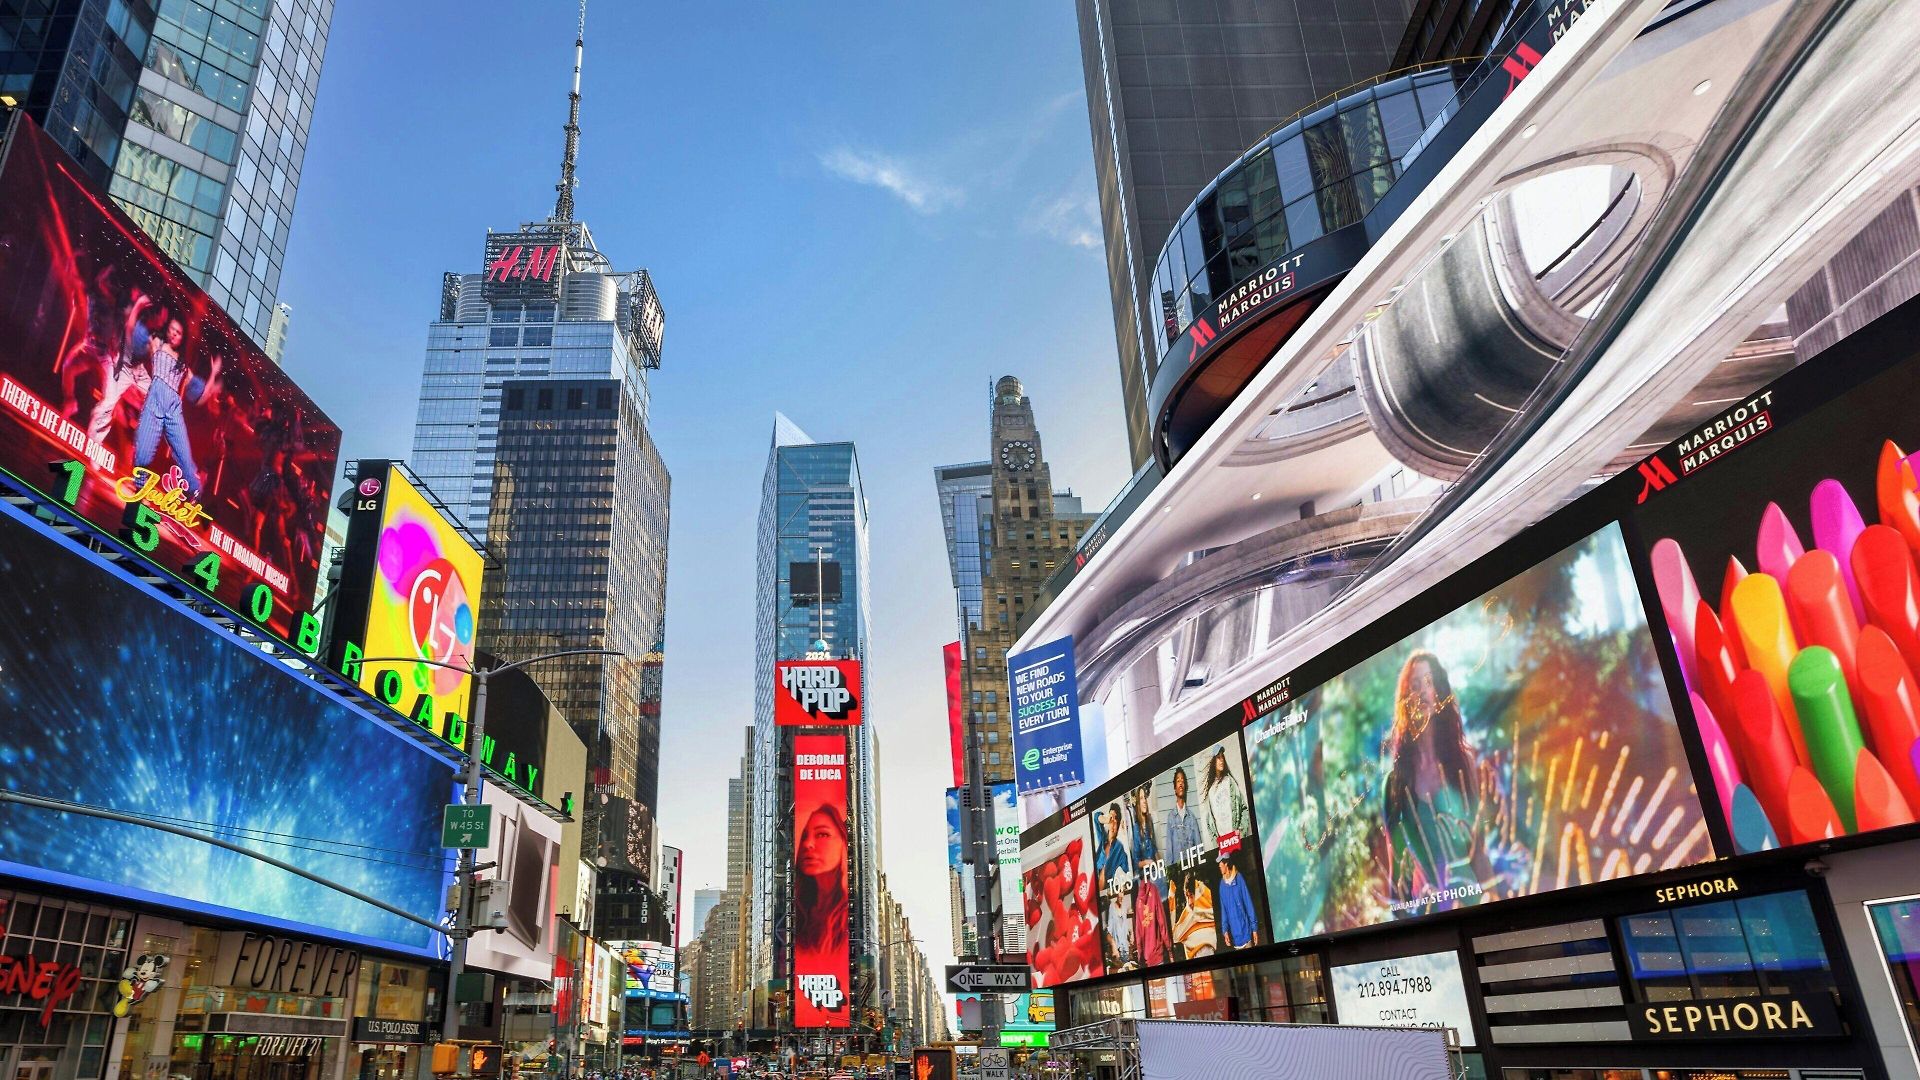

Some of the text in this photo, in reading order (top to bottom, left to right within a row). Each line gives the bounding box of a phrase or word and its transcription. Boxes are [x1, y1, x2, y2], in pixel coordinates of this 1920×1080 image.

[488, 246, 560, 283] H&M
[1218, 253, 1305, 315] MARRIOTT
[1220, 276, 1293, 329] MARQUIS
[0, 378, 116, 474] THERE'S LIFE AFTER ROMEO.
[1678, 390, 1773, 456] MARRIOTT
[1683, 415, 1768, 472] MARQUIS
[115, 466, 213, 528] Juliet
[357, 500, 377, 511] LG
[210, 525, 224, 548] THE
[221, 534, 235, 555] HIT
[805, 651, 831, 660] 2024
[779, 666, 841, 700] HARD
[1015, 665, 1050, 684] WE FIND
[1016, 671, 1066, 696] NEW ROADS
[297, 611, 538, 791] BROADWAY
[799, 687, 850, 713] POP
[1017, 687, 1053, 706] TO YOUR
[1256, 676, 1291, 703] MARRIOTT
[1258, 690, 1289, 713] MARQUIS
[1018, 694, 1069, 718] SUCCESS AT
[1019, 705, 1070, 729] EVERY TURN
[796, 754, 845, 766] DEBORAH
[1042, 742, 1073, 756] Enterprise
[800, 769, 841, 780] DE LUCA
[450, 821, 484, 830] W 45 St
[462, 809, 474, 818] TO
[1005, 837, 1019, 845] One
[1143, 859, 1167, 884] FOR
[1179, 843, 1207, 872] LIFE
[1389, 883, 1483, 912] AVAILABLE AT SEPHORA
[1656, 877, 1739, 903] SEPHORA
[230, 932, 358, 998] FOREVER
[1380, 965, 1401, 978] CALL
[797, 974, 838, 999] HARD
[959, 974, 983, 985] ONE
[994, 974, 1020, 985] WAY
[1357, 976, 1432, 998] 212.894.7988
[811, 990, 844, 1008] POP
[1379, 1008, 1417, 1021] CONTACT
[1645, 1000, 1815, 1034] SEPHORA
[368, 1020, 420, 1035] U.S. POLO ASSN.
[254, 1036, 322, 1057] FOREVER 21
[986, 1069, 1005, 1078] WALK
